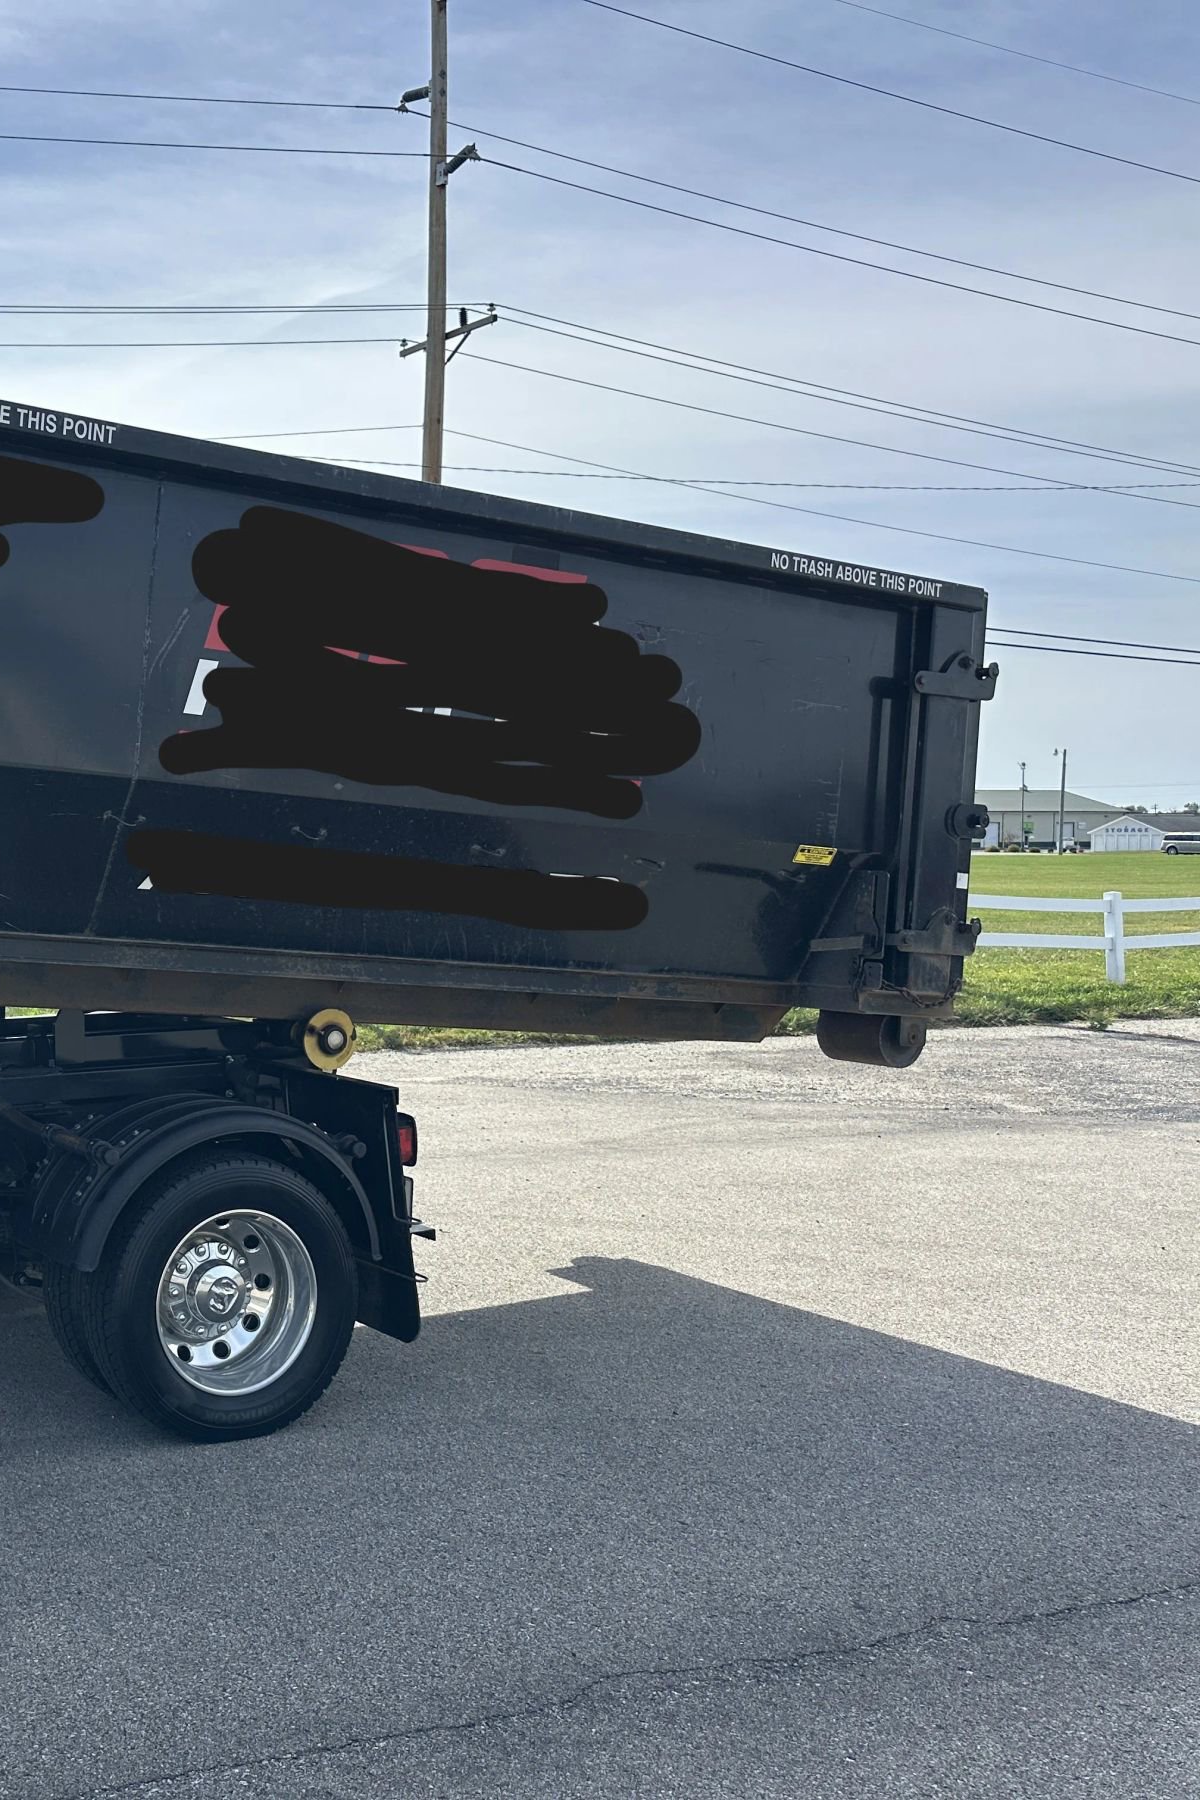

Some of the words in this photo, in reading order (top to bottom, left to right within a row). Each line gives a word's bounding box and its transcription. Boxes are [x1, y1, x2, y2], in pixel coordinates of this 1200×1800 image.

[16, 408, 57, 434] THIS
[62, 417, 117, 444] POINT
[770, 552, 789, 570] NO
[792, 557, 833, 578] TRASH
[835, 565, 877, 586] ABOVE
[879, 572, 905, 592] THIS
[908, 579, 942, 598] POINT
